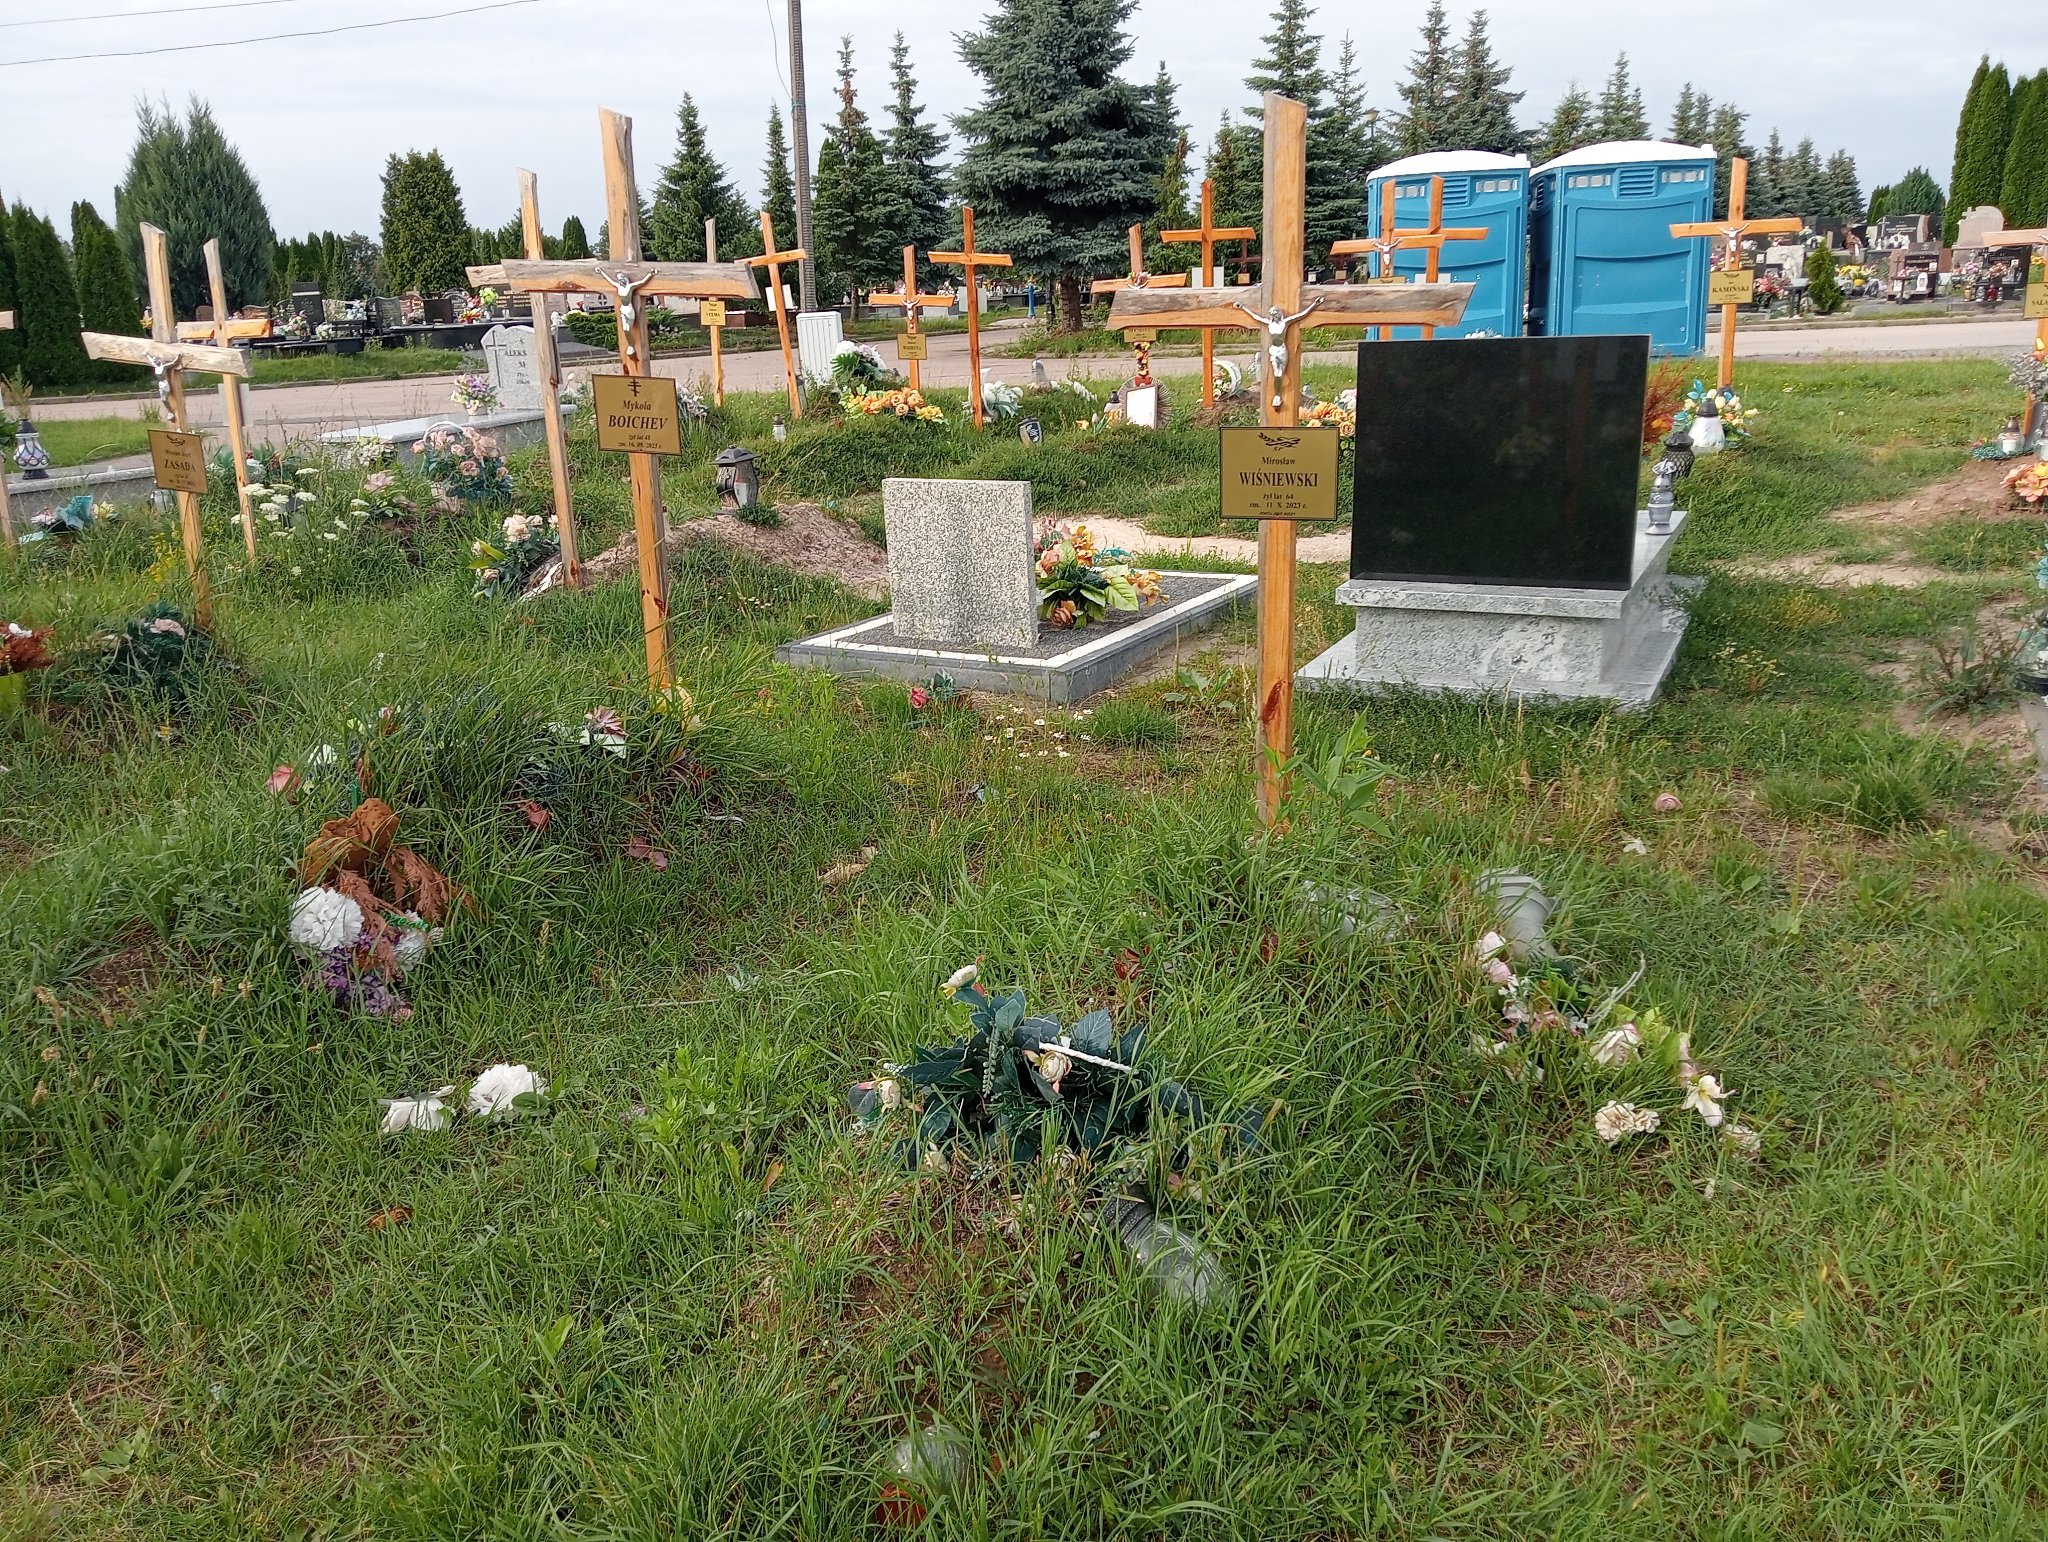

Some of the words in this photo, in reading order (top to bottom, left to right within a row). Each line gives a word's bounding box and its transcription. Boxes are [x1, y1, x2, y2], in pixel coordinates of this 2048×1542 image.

[622, 400, 652, 411] Mykola
[608, 414, 668, 430] BOICHEV
[164, 459, 196, 472] ZASADA
[1261, 456, 1296, 465] Mirosław
[1239, 468, 1319, 487] WIŚNIEWSKI
